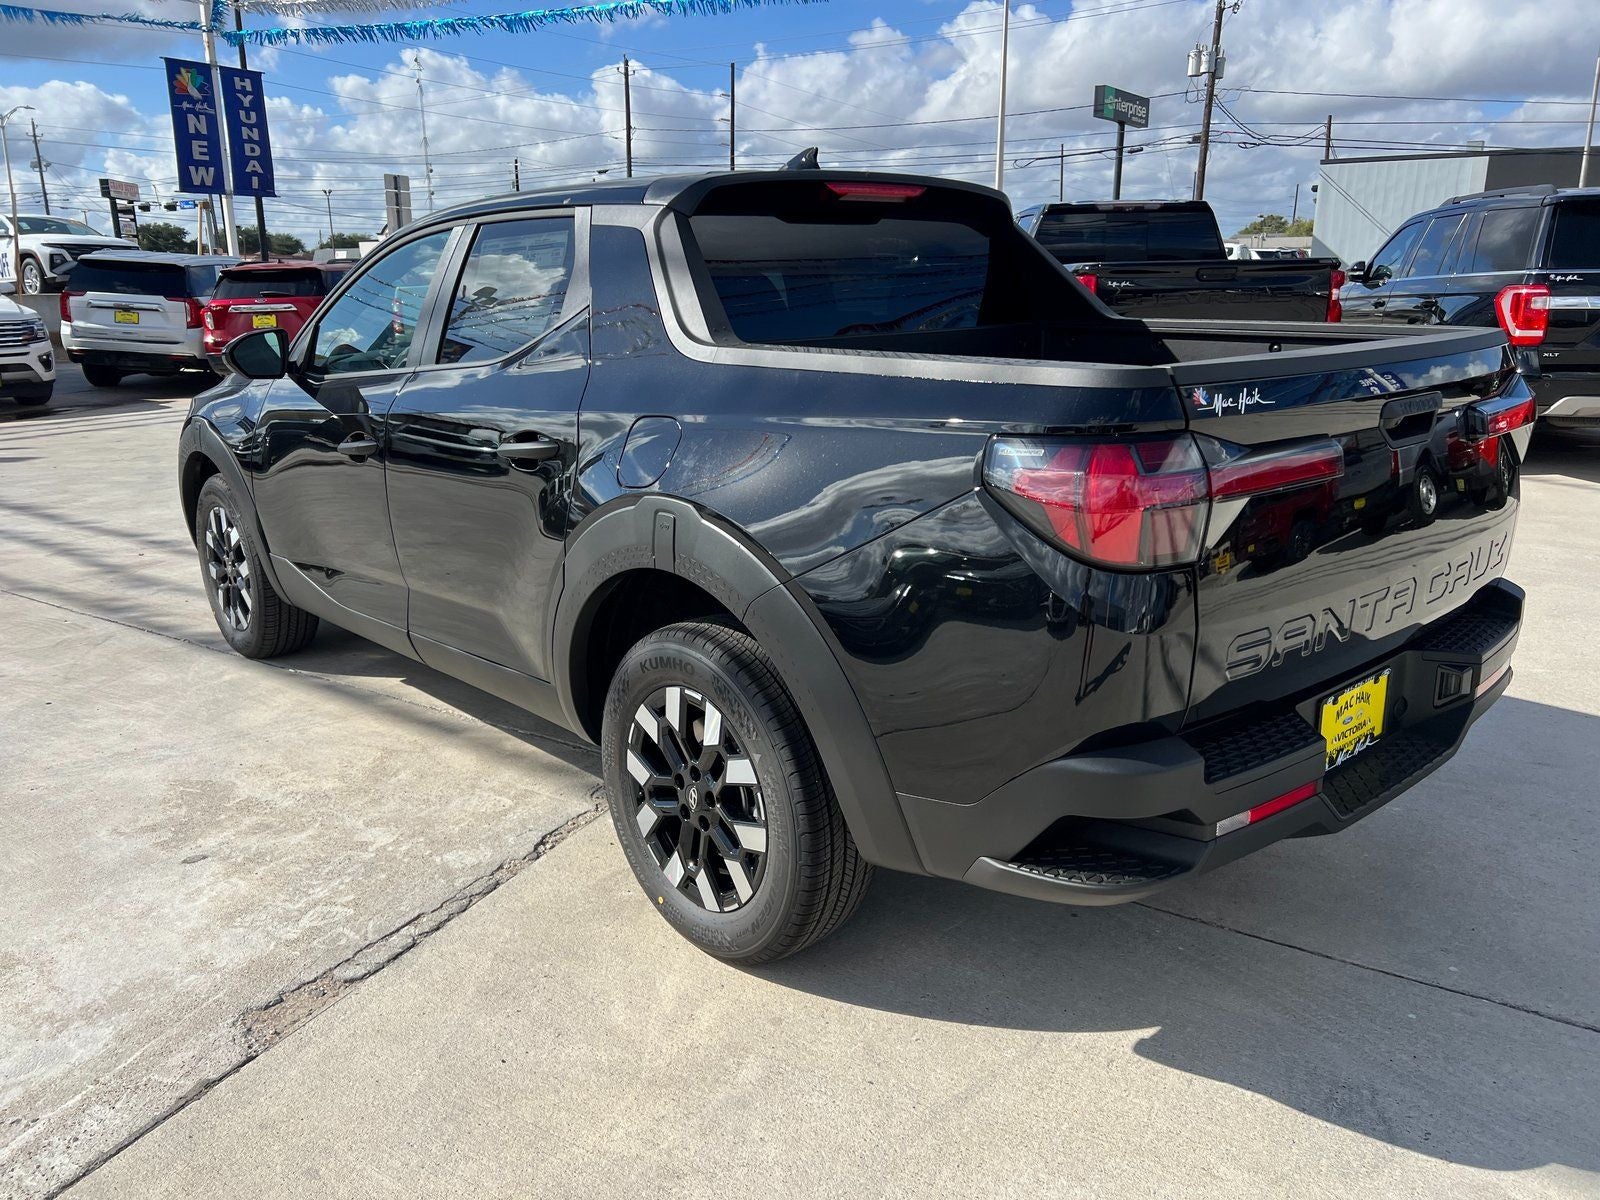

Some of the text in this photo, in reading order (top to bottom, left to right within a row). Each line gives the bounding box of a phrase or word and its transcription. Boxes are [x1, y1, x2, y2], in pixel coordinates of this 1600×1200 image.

[186, 113, 215, 187] NEW
[233, 76, 264, 189] HYUNDAI
[1197, 387, 1276, 417] Mac Haik
[1225, 531, 1509, 682] SANTA CRUZ
[640, 656, 696, 675] KUMHO
[1336, 696, 1355, 722] MAC
[1355, 690, 1371, 705] HAIK
